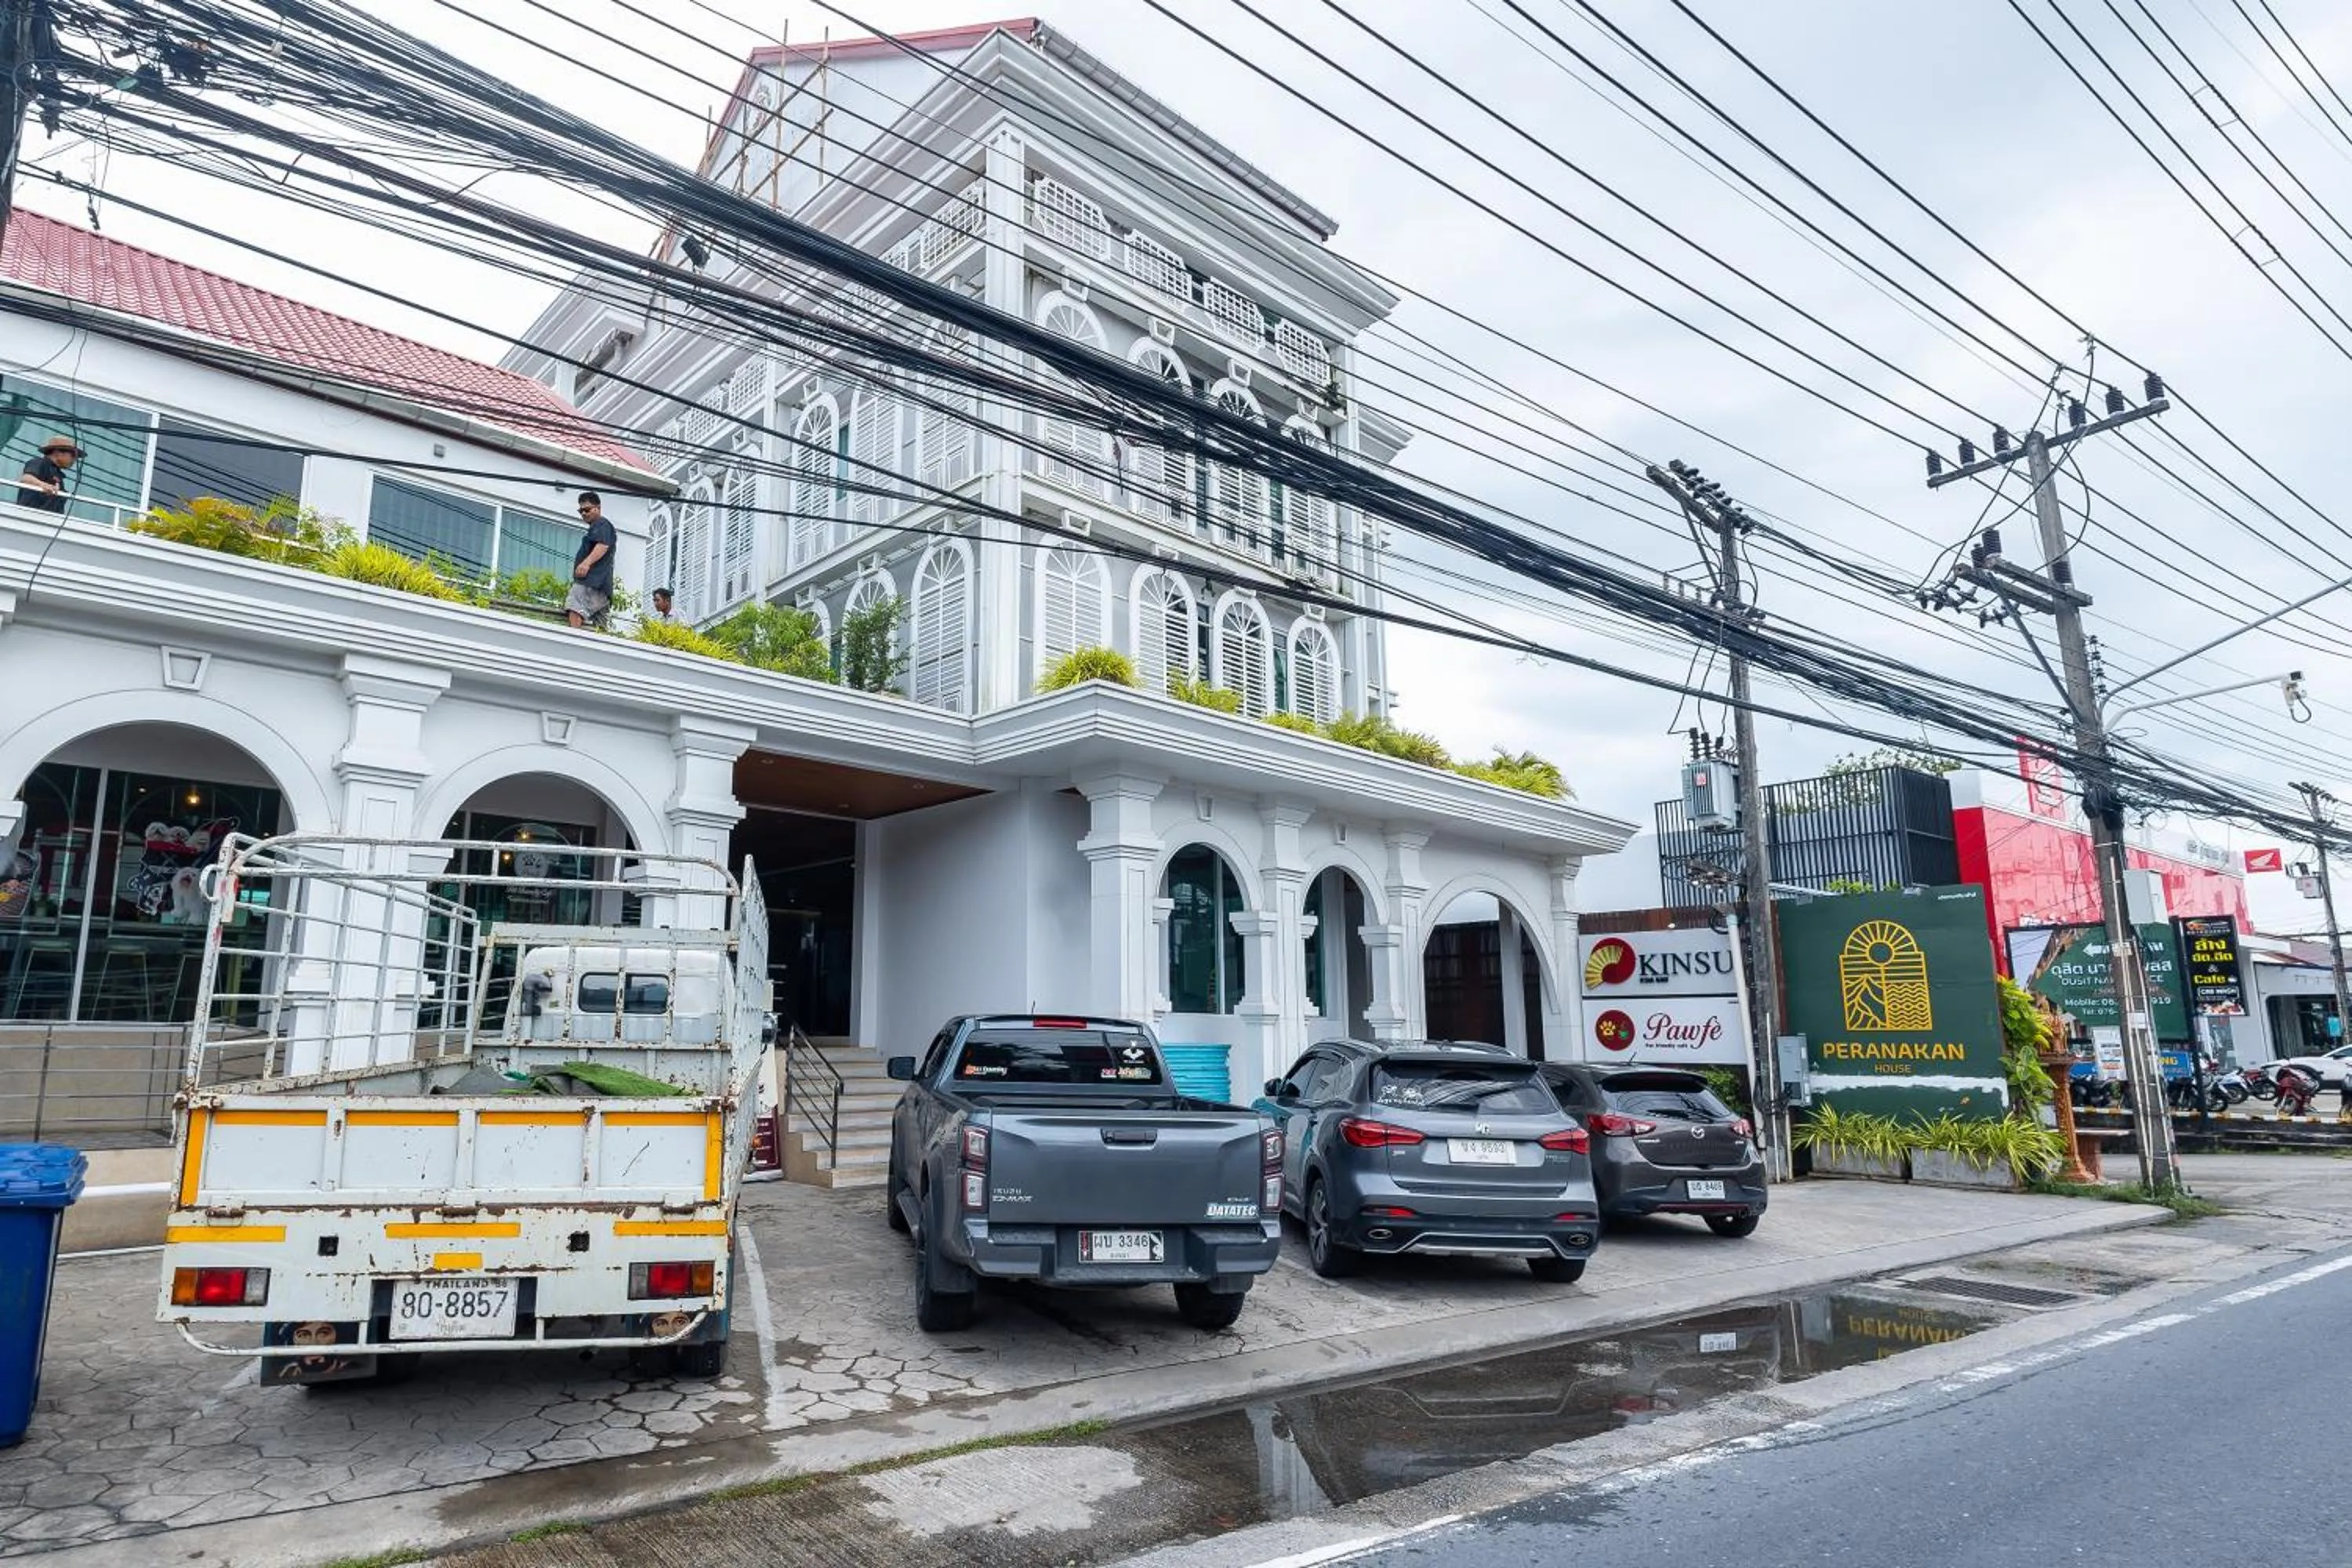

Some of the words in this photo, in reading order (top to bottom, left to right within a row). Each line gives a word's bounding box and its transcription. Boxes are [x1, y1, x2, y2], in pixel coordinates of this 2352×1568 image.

[1823, 1043, 1965, 1060] PERANAKAN
[1875, 1064, 1911, 1073] HOUSE
[1119, 1235, 1148, 1247] 3346
[426, 1279, 488, 1288] THAILAND
[401, 1291, 508, 1319] 80-8857
